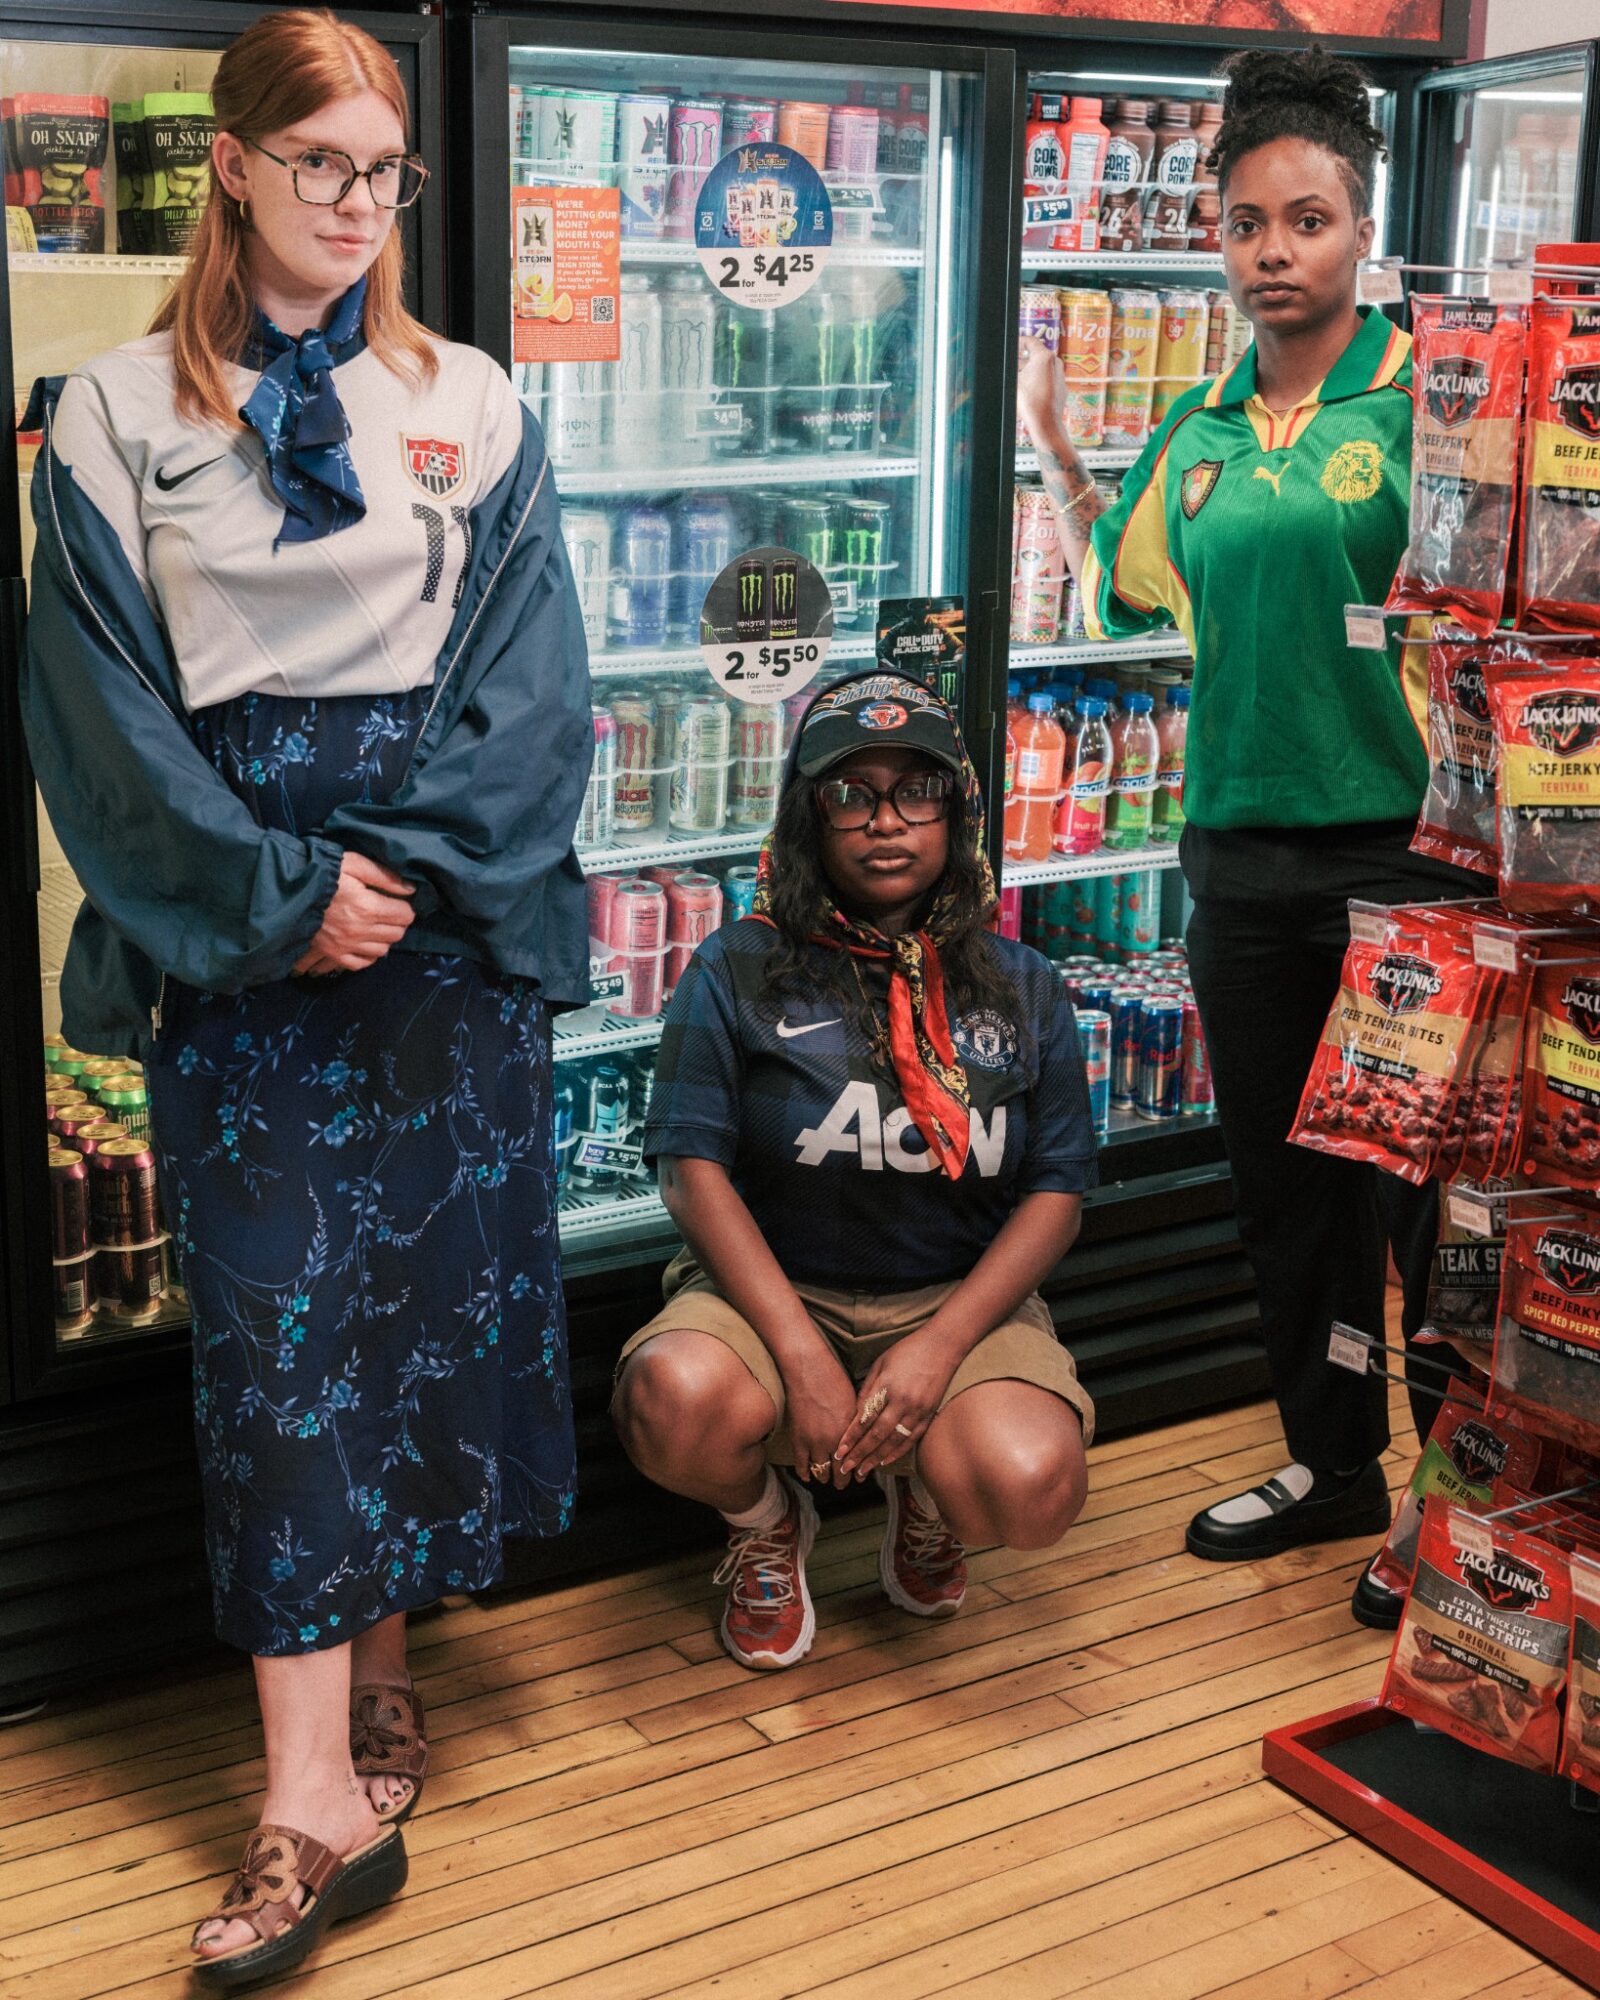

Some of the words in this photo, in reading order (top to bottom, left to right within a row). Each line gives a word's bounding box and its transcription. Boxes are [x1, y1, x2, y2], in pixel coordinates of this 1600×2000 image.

[31, 130, 50, 146] OH
[55, 130, 98, 147] SNAP!
[155, 132, 172, 148] OH
[177, 131, 216, 147] SNAP
[556, 200, 584, 209] WE'RE
[556, 210, 596, 219] PUTTING
[597, 211, 617, 220] OUR
[556, 220, 589, 229] MONEY
[556, 230, 588, 239] WHERE
[590, 230, 615, 239] YOUR
[556, 240, 590, 249] MOUTH
[592, 241, 603, 249] IS.
[719, 256, 740, 288] 2
[742, 279, 756, 288] for
[1444, 310, 1474, 322] FAMILY
[1475, 311, 1493, 323] SIZE
[1576, 314, 1600, 327] FAM
[1422, 371, 1450, 393] JACK
[1549, 379, 1595, 404] JACK
[1554, 444, 1583, 459] BEEF
[412, 451, 458, 478] US
[1563, 464, 1600, 479] TERIYA
[830, 590, 848, 601] 550
[897, 636, 916, 648] CALL
[921, 634, 944, 646] DUTY
[725, 651, 745, 681] 2
[746, 671, 760, 680] for
[1449, 668, 1486, 691] JACK
[1519, 705, 1561, 727] JACK
[1561, 704, 1600, 725] LINK
[1453, 723, 1473, 739] EEF
[1473, 727, 1492, 742] JER
[1561, 763, 1600, 776] JERKY
[1541, 781, 1590, 794] TERIYAKI
[1367, 961, 1402, 984] JACK
[1561, 985, 1593, 1013] JACK
[1342, 1007, 1363, 1023] BEEF
[1365, 1013, 1406, 1035] TENDER
[1407, 1026, 1445, 1046] BITES
[1541, 1033, 1564, 1051] BEEF
[969, 1051, 1005, 1065] UNITED
[1567, 1061, 1600, 1080] TERIYA
[1438, 1248, 1480, 1273] TEAK
[1533, 1236, 1572, 1264] JACK
[1572, 1247, 1600, 1273] LIN
[1531, 1289, 1562, 1308] BEEF
[1562, 1299, 1600, 1321] JERKY
[1523, 1303, 1549, 1323] SPICY
[1550, 1313, 1568, 1329] RED
[1569, 1320, 1600, 1340] PEPPE
[1451, 1425, 1479, 1456] JACK
[1436, 1469, 1458, 1491] BEEF
[1454, 1549, 1498, 1580] JACK
[1452, 1596, 1484, 1617] EXTRA
[1486, 1611, 1511, 1630] THICK
[1512, 1625, 1532, 1638] CUT
[1437, 1600, 1486, 1631] STEAK
[1487, 1624, 1541, 1656] STRIPS
[1450, 1646, 1467, 1662] 100%
[1467, 1654, 1479, 1666] BEEF
[1457, 1629, 1507, 1662] ORIGINAL
